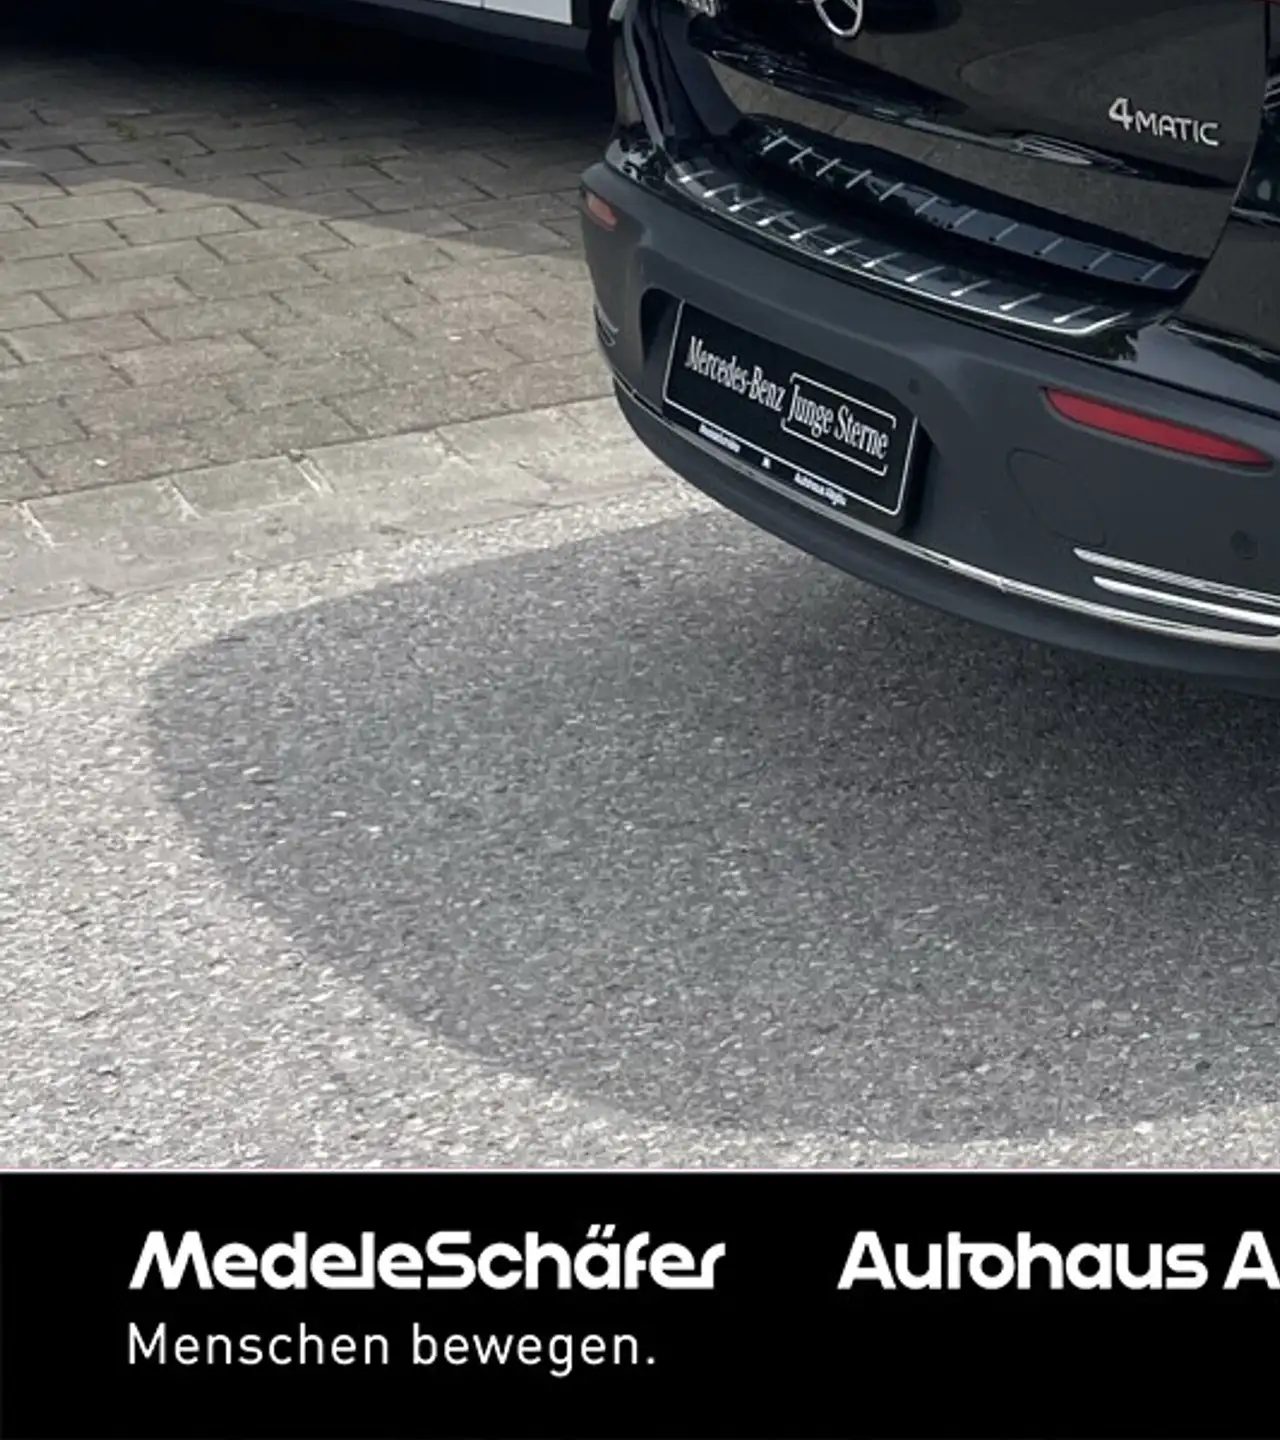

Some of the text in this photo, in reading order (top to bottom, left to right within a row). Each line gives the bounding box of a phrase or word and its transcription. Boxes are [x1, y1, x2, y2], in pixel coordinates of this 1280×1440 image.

[1108, 97, 1219, 147] 4MATIC
[685, 335, 786, 412] Mercedes-Benz
[787, 383, 835, 438] Junge
[834, 405, 889, 460] Sterne
